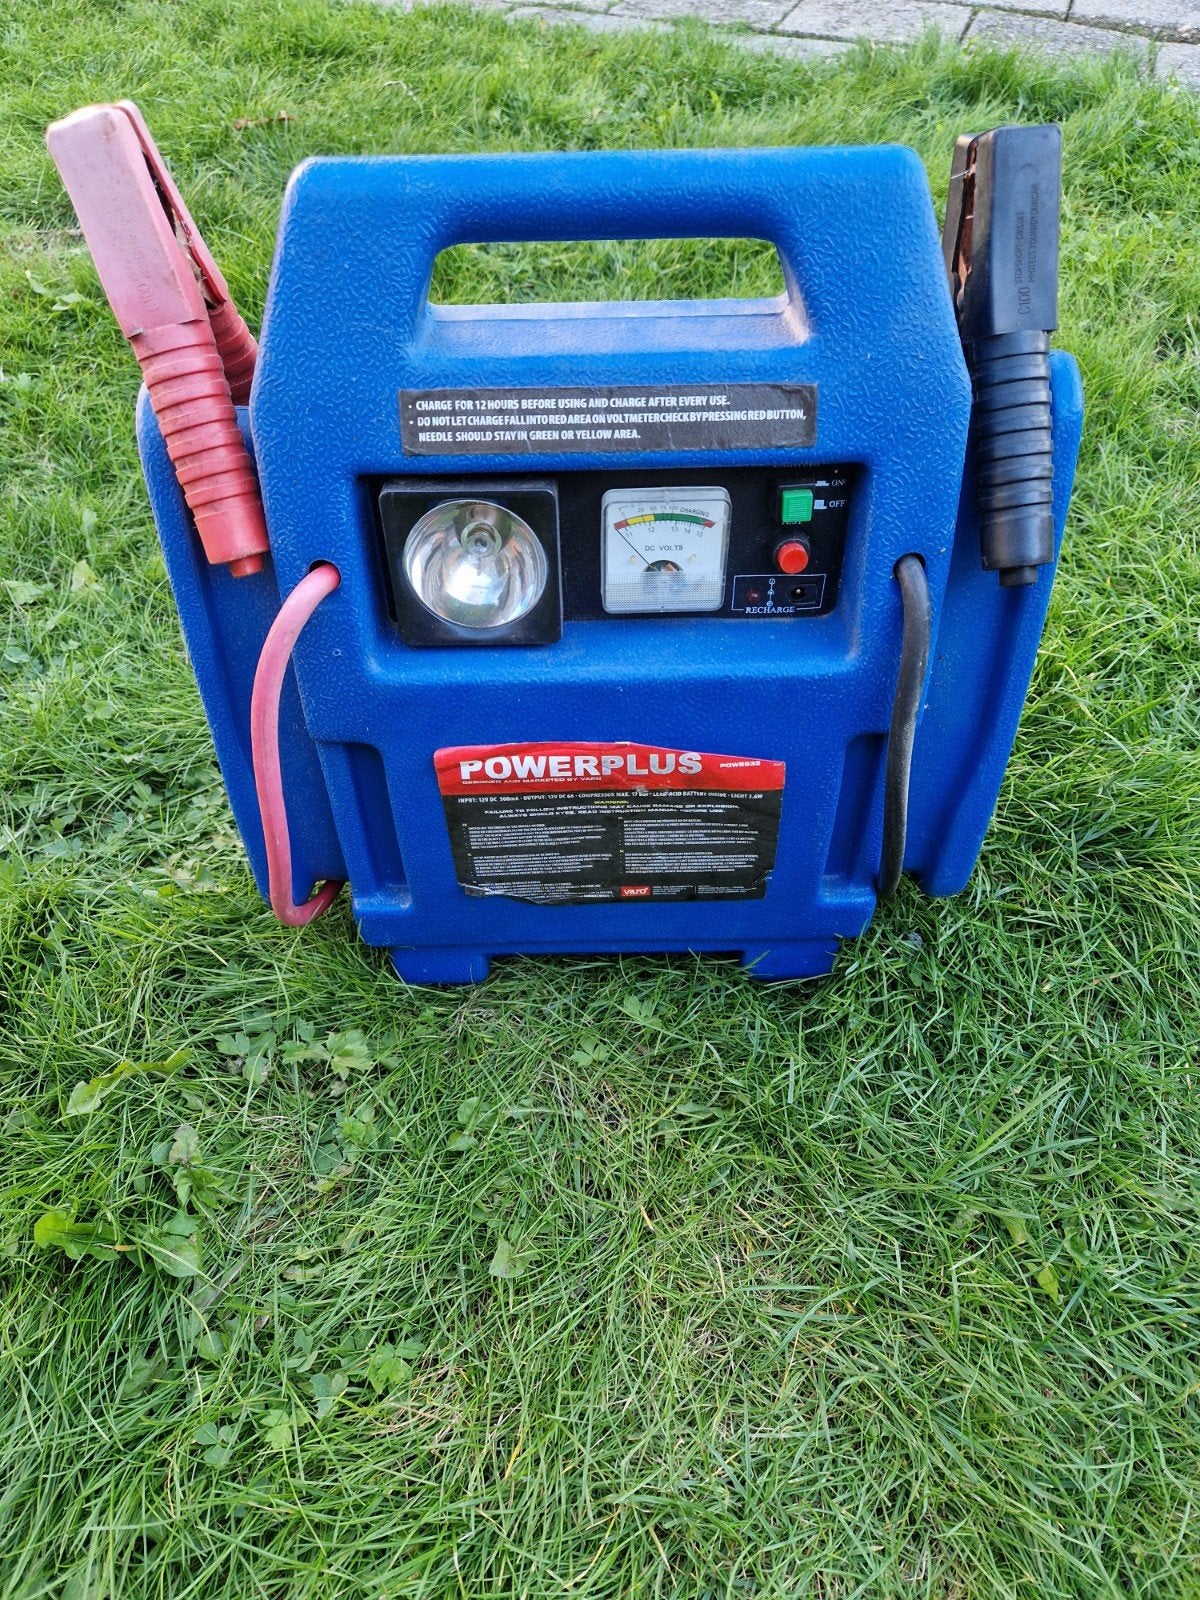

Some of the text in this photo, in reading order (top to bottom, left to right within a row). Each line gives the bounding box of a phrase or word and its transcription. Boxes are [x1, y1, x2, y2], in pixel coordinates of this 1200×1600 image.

[416, 395, 730, 411] CHARGE FOR 12 HOURS BEFORE USING AND CHARGE AFTER EVERY USE.
[417, 409, 807, 427] DO NOT LET CHARGE FALL INTO RED AREA ON VOLTMETER CHECK BY PRESSING RED BUTTON,
[418, 429, 641, 442] NEEDLE SHOULD STAY IN GREEN OR YELLOW AREA.
[829, 500, 845, 508] OFF
[680, 507, 710, 518] CHARGING
[745, 606, 795, 614] RECHARGE
[459, 752, 703, 780] POWERPLUS
[682, 790, 707, 798] BATTERY
